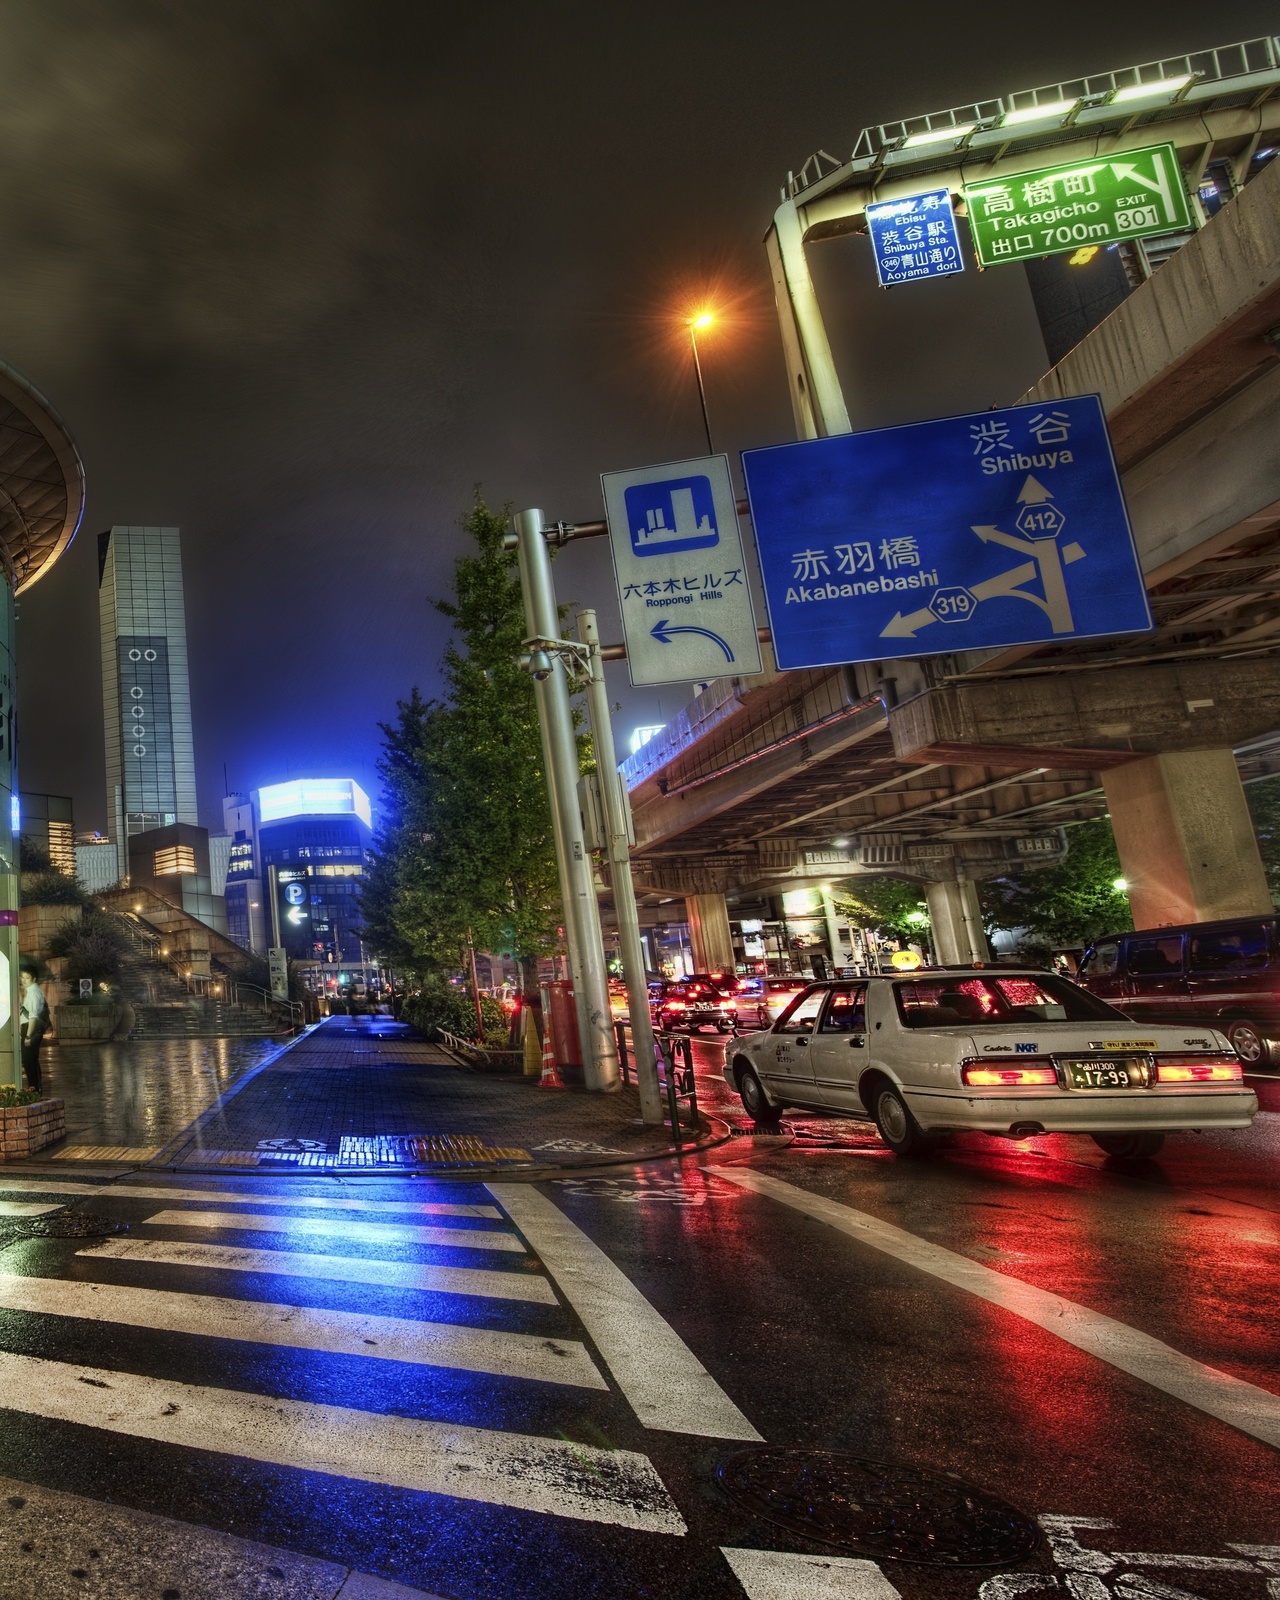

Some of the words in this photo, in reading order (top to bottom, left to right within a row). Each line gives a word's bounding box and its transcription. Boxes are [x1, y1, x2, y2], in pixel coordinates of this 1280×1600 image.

[983, 166, 1097, 216] 高樹町
[1116, 193, 1147, 208] EXIT
[895, 214, 926, 226] Ebisu
[988, 201, 1101, 231] Takagicho
[1119, 207, 1157, 229] 301
[881, 220, 948, 247] 渋谷駅
[991, 233, 1034, 257] 出口
[1040, 222, 1110, 246] 700m
[883, 241, 925, 255] Shibuya
[928, 236, 949, 246] Sta.
[884, 259, 898, 268] 246
[901, 246, 956, 269] 青山通り
[887, 267, 930, 281] Aoyama
[936, 260, 958, 271] dori
[969, 411, 1072, 456] 渋谷
[981, 449, 1074, 475] Shibuya
[1023, 511, 1058, 531] 412
[791, 536, 921, 582] 赤羽橋
[623, 568, 743, 600] 六本木ヒルズ
[785, 569, 939, 605] Akabanebashi
[646, 594, 693, 608] Roppongi
[700, 590, 723, 601] Hills
[936, 595, 970, 615] 319
[289, 886, 302, 902] P
[1085, 1071, 1129, 1085] 17-99
